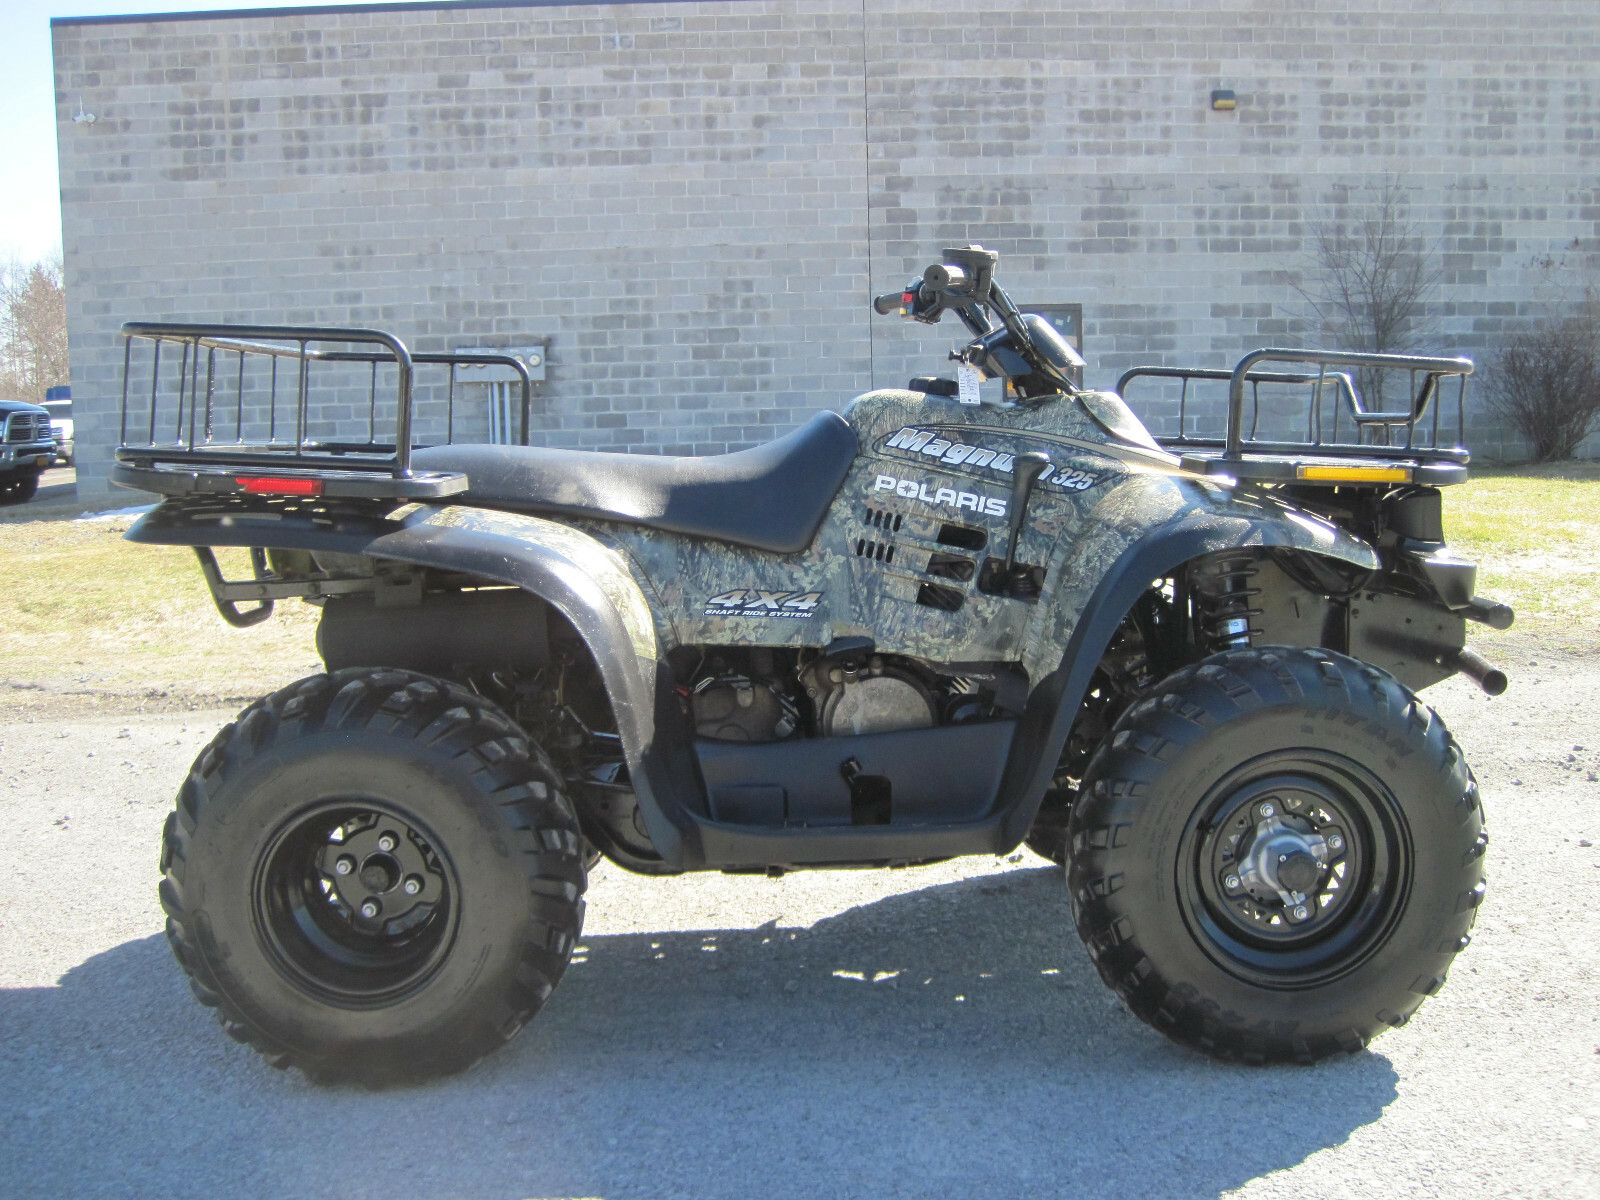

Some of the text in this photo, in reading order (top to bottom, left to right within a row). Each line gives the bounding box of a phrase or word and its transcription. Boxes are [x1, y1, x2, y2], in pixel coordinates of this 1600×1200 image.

[1051, 467, 1099, 491] 325
[873, 474, 1008, 517] POLARIS
[706, 589, 823, 610] 4X4
